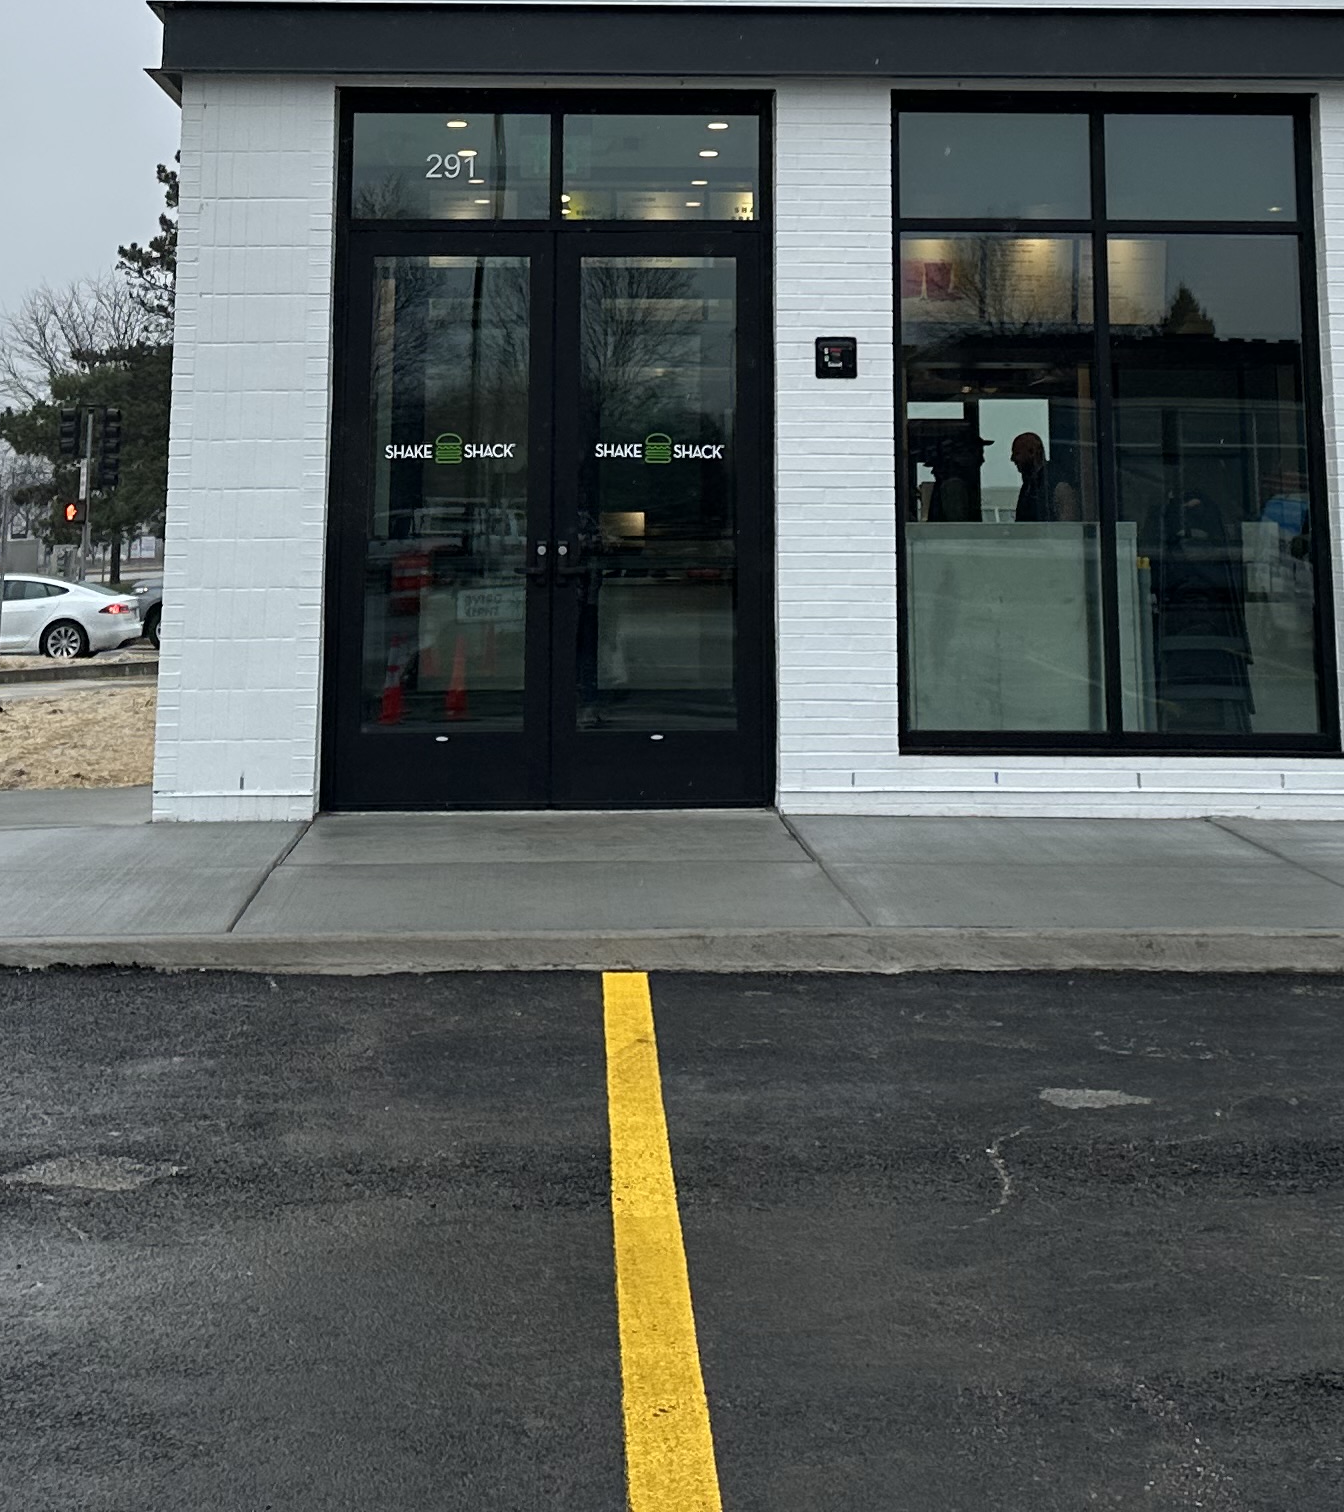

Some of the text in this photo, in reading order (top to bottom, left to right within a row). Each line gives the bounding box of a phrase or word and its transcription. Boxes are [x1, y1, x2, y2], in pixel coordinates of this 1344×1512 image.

[425, 153, 476, 179] 291
[384, 443, 514, 459] SHAKE SHACK
[595, 443, 723, 459] SHAKE SHACK
